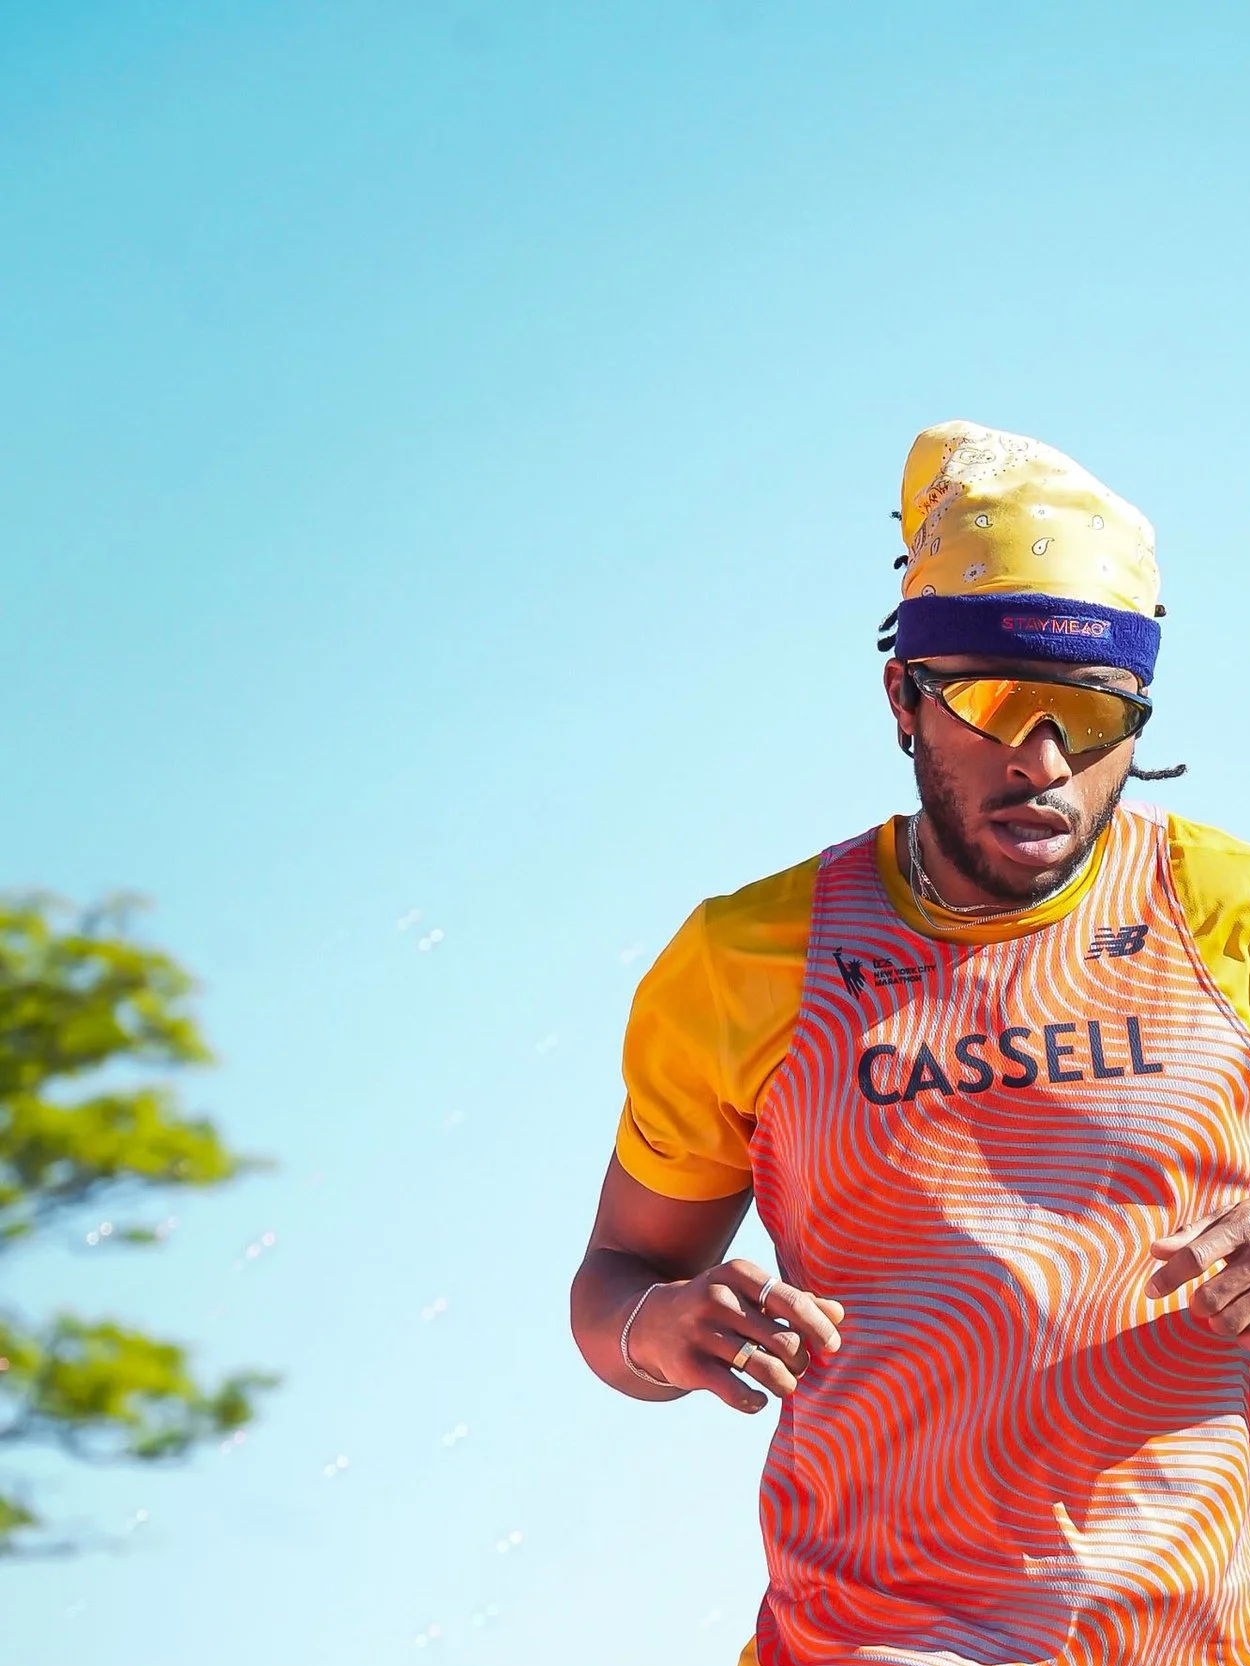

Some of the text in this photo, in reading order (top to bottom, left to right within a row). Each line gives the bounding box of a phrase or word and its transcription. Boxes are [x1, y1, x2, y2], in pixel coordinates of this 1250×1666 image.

[895, 967, 917, 975] YORK
[875, 975, 922, 987] MARATHON
[858, 1016, 1163, 1105] CASSELL
